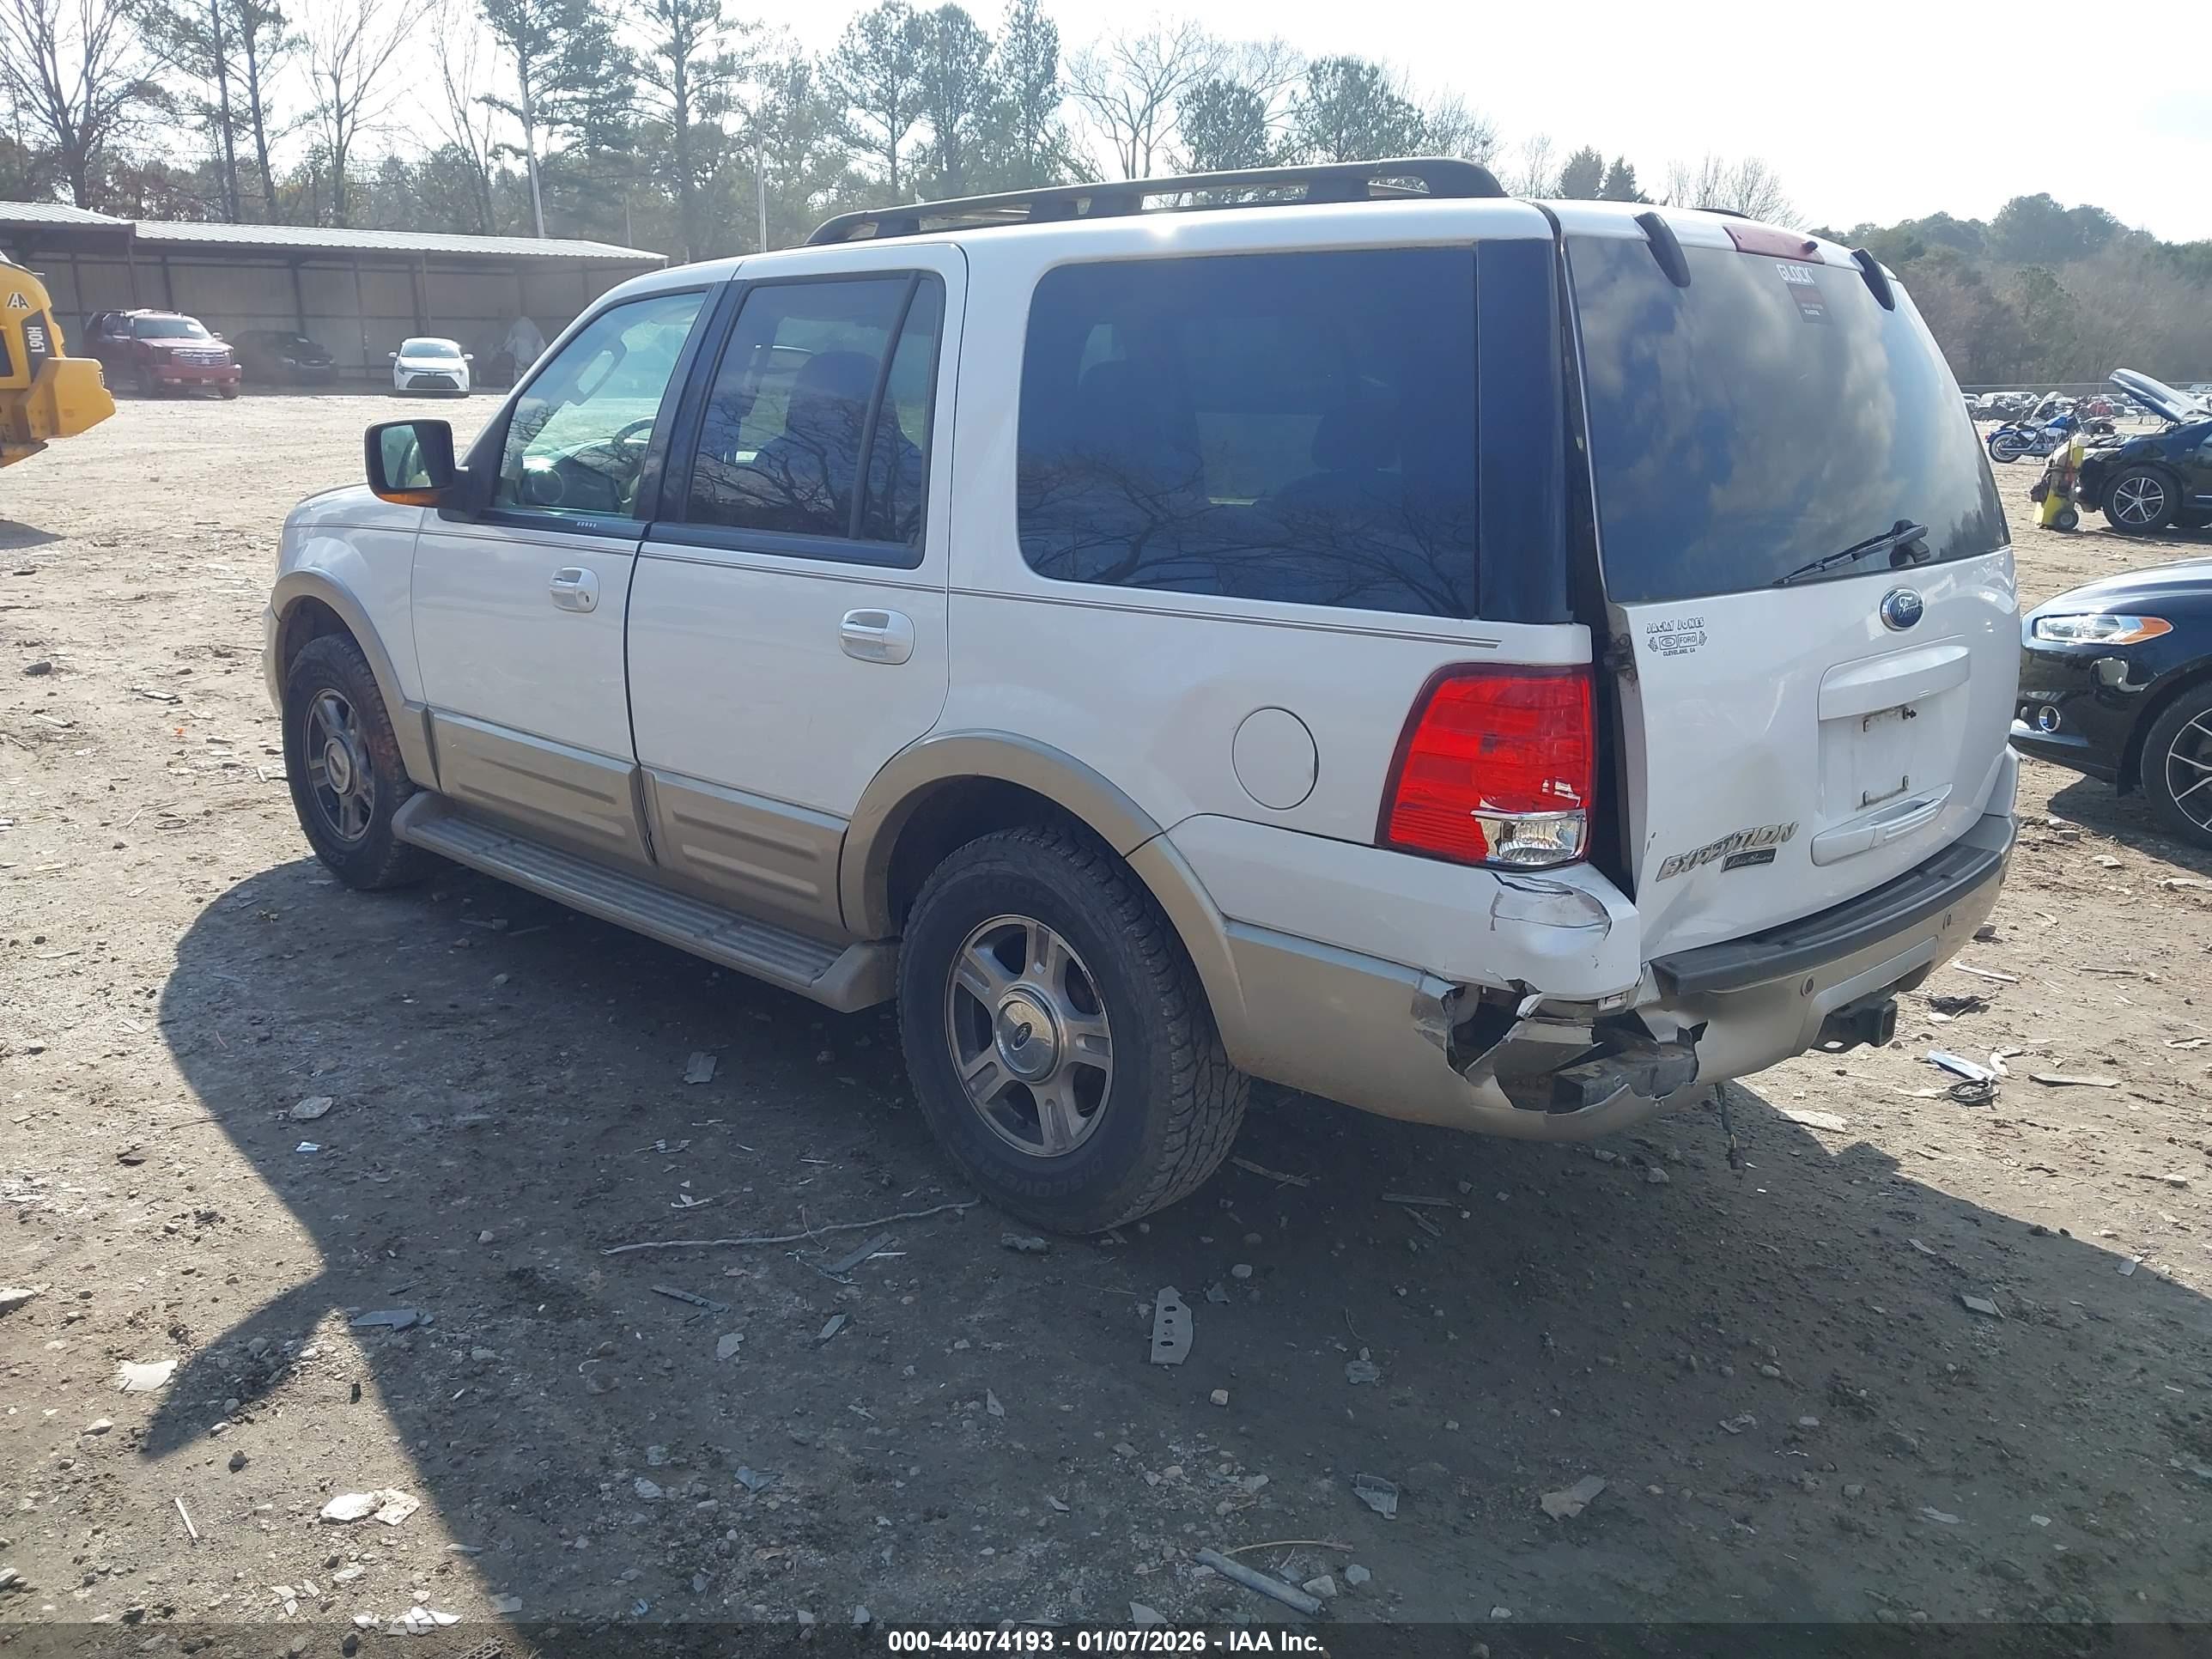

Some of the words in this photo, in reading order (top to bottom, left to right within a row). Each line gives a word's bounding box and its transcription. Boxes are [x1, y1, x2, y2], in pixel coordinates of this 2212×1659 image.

[1776, 264, 1814, 283] GLOCK
[27, 326, 46, 353] L90H
[1646, 620, 1674, 634] JACKY
[1677, 617, 1704, 630] JONES
[1679, 635, 1696, 644] FORD
